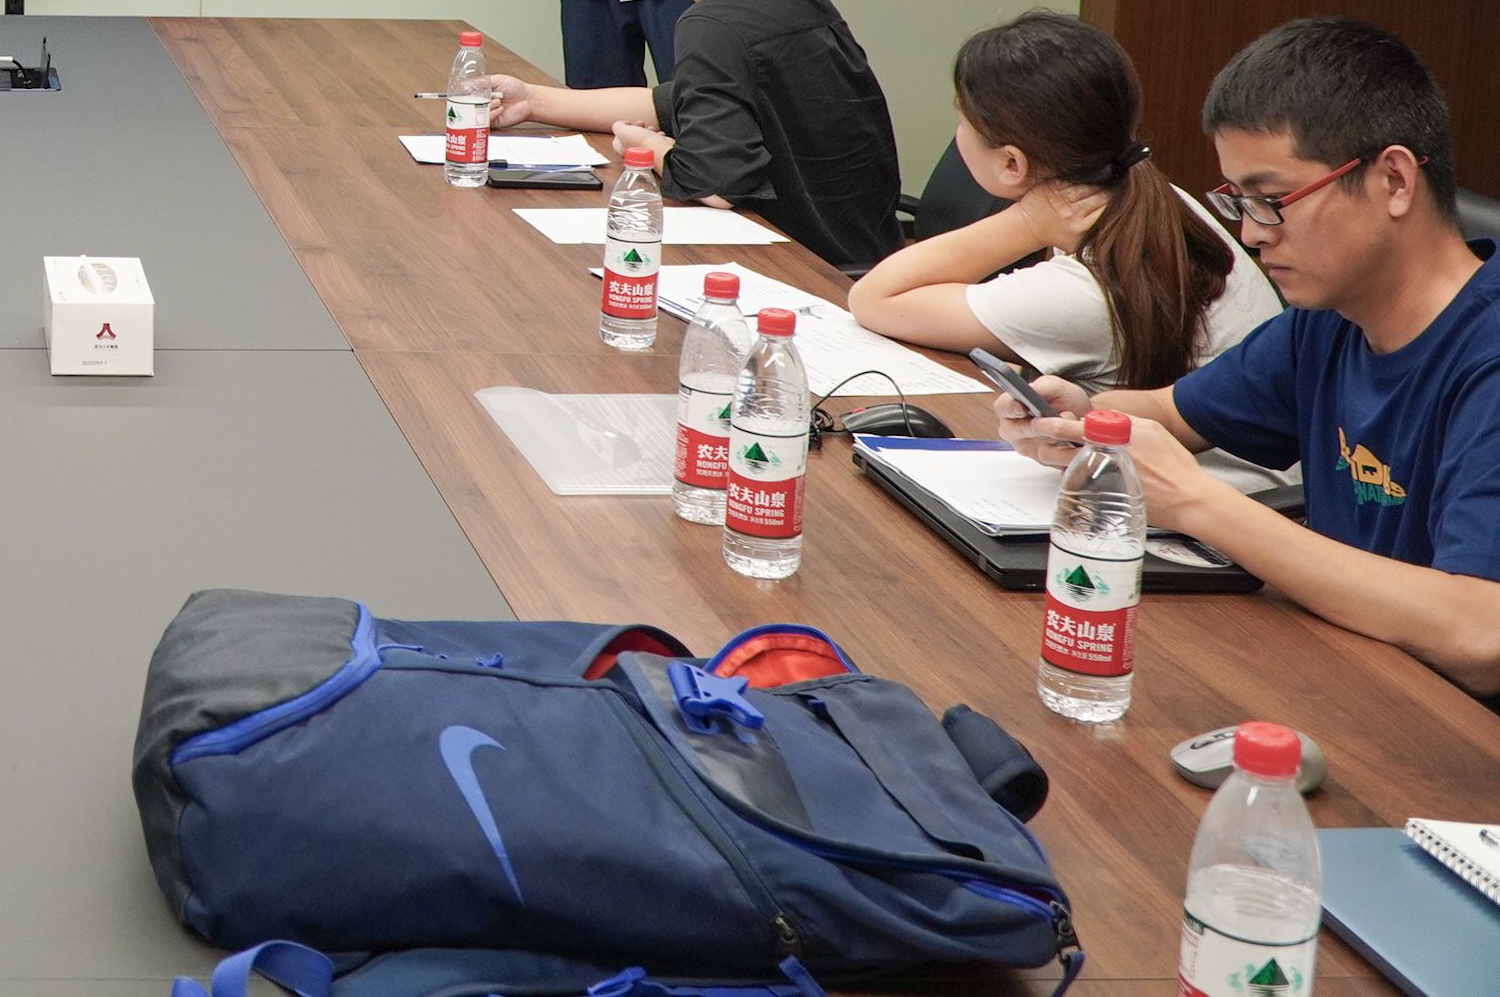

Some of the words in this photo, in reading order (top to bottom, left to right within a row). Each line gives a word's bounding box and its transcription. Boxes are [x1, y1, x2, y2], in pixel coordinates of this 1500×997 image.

[609, 281, 653, 297] 农夫山泉
[729, 483, 786, 508] 农夫山泉
[755, 507, 785, 518] SPRING
[1046, 609, 1115, 642] 农夫山泉
[1076, 640, 1114, 653] SPRING
